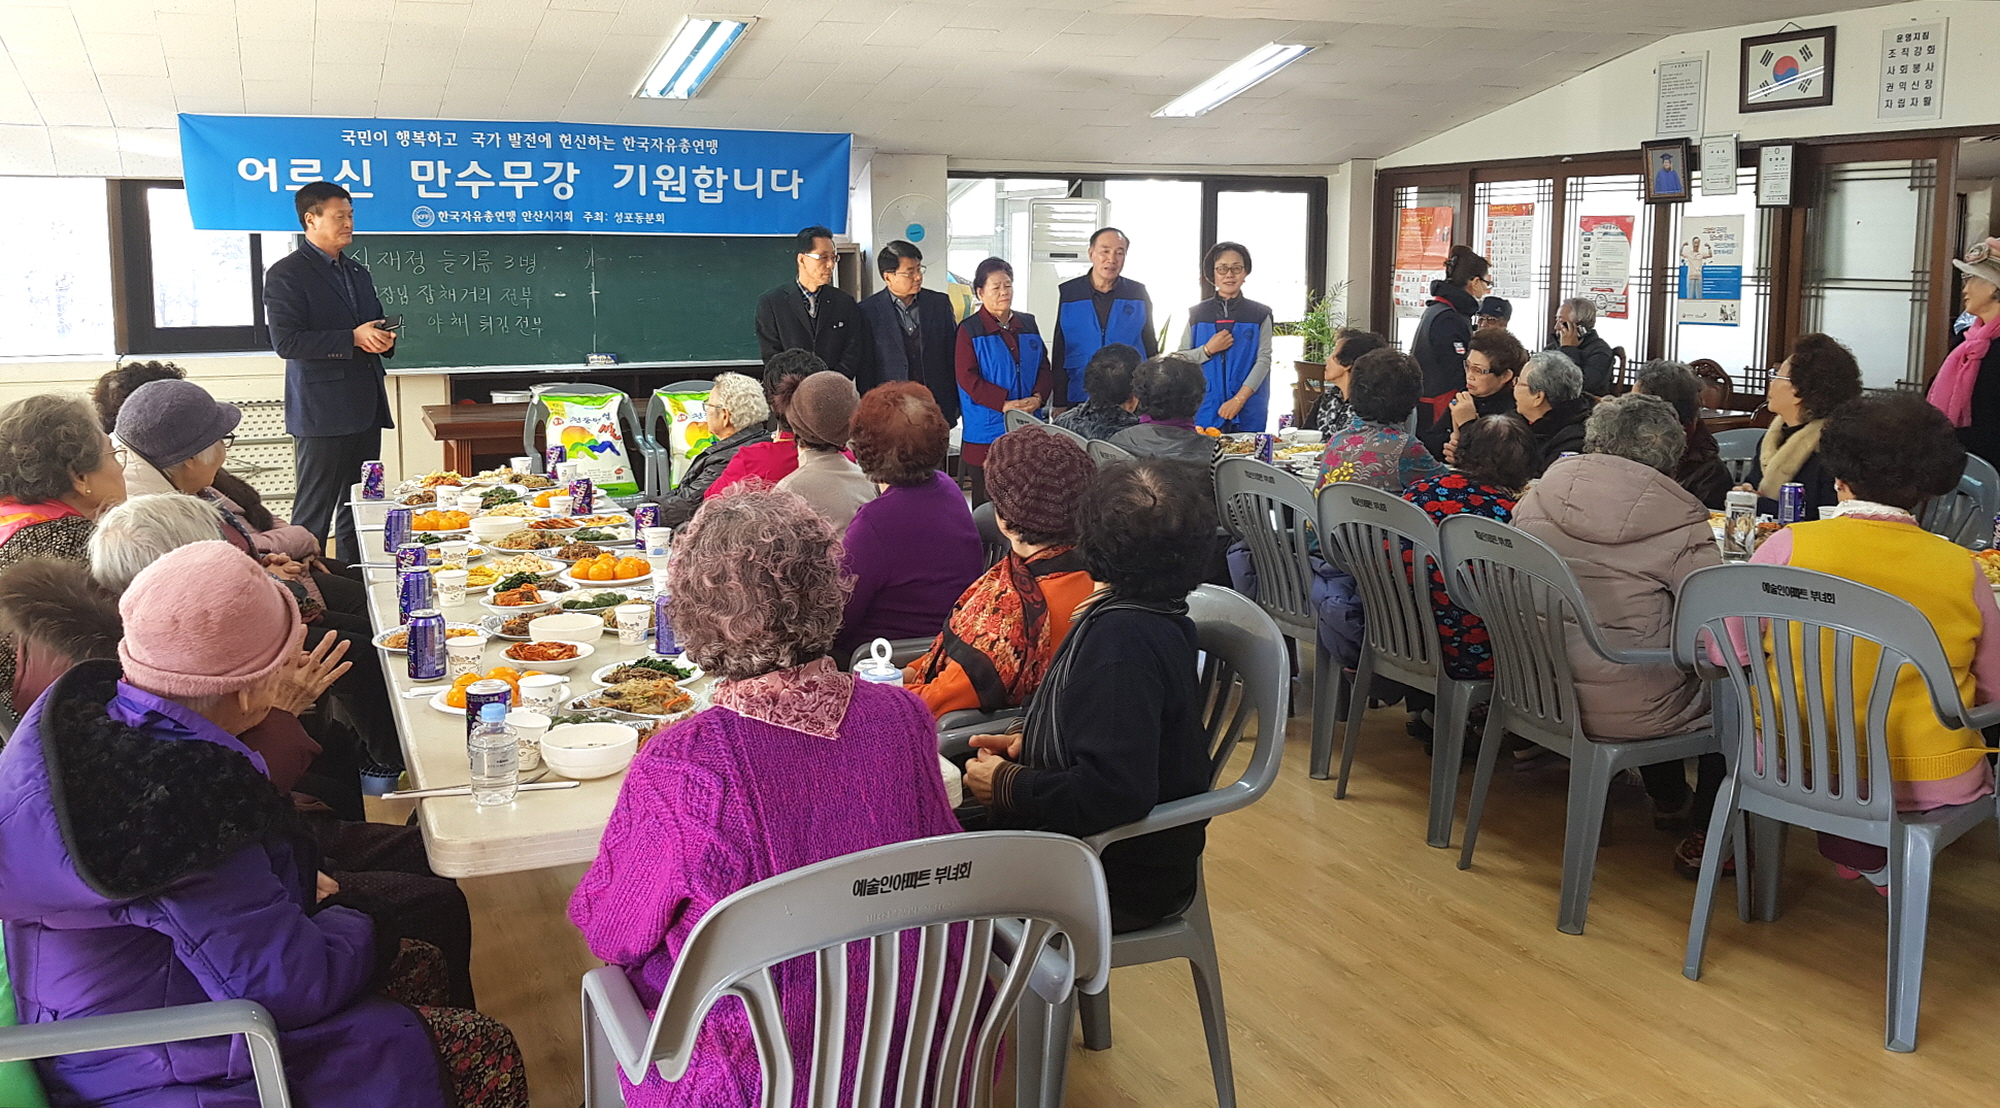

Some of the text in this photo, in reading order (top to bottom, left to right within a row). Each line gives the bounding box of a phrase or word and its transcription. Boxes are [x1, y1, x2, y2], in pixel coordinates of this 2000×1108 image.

[1896, 31, 1930, 43] 운영지침
[1888, 45, 1936, 59] 조직강화
[1886, 61, 1934, 75] 사회봉사
[1886, 79, 1933, 93] 권익신장
[341, 129, 719, 155] 국민이 행복하고 국가 발전에 헌신하는 한국자유총연맹
[237, 157, 804, 204] 어르신 만수무강 기원합니다
[438, 209, 666, 225] 한국자유총연맹 안산시지회 주최: 성포동분회
[374, 284, 533, 310] 장님 잡채거리 전부
[514, 315, 544, 338] 전부
[1810, 589, 1836, 605] 부녀회
[852, 860, 973, 897] 예술인아파트 부녀회
